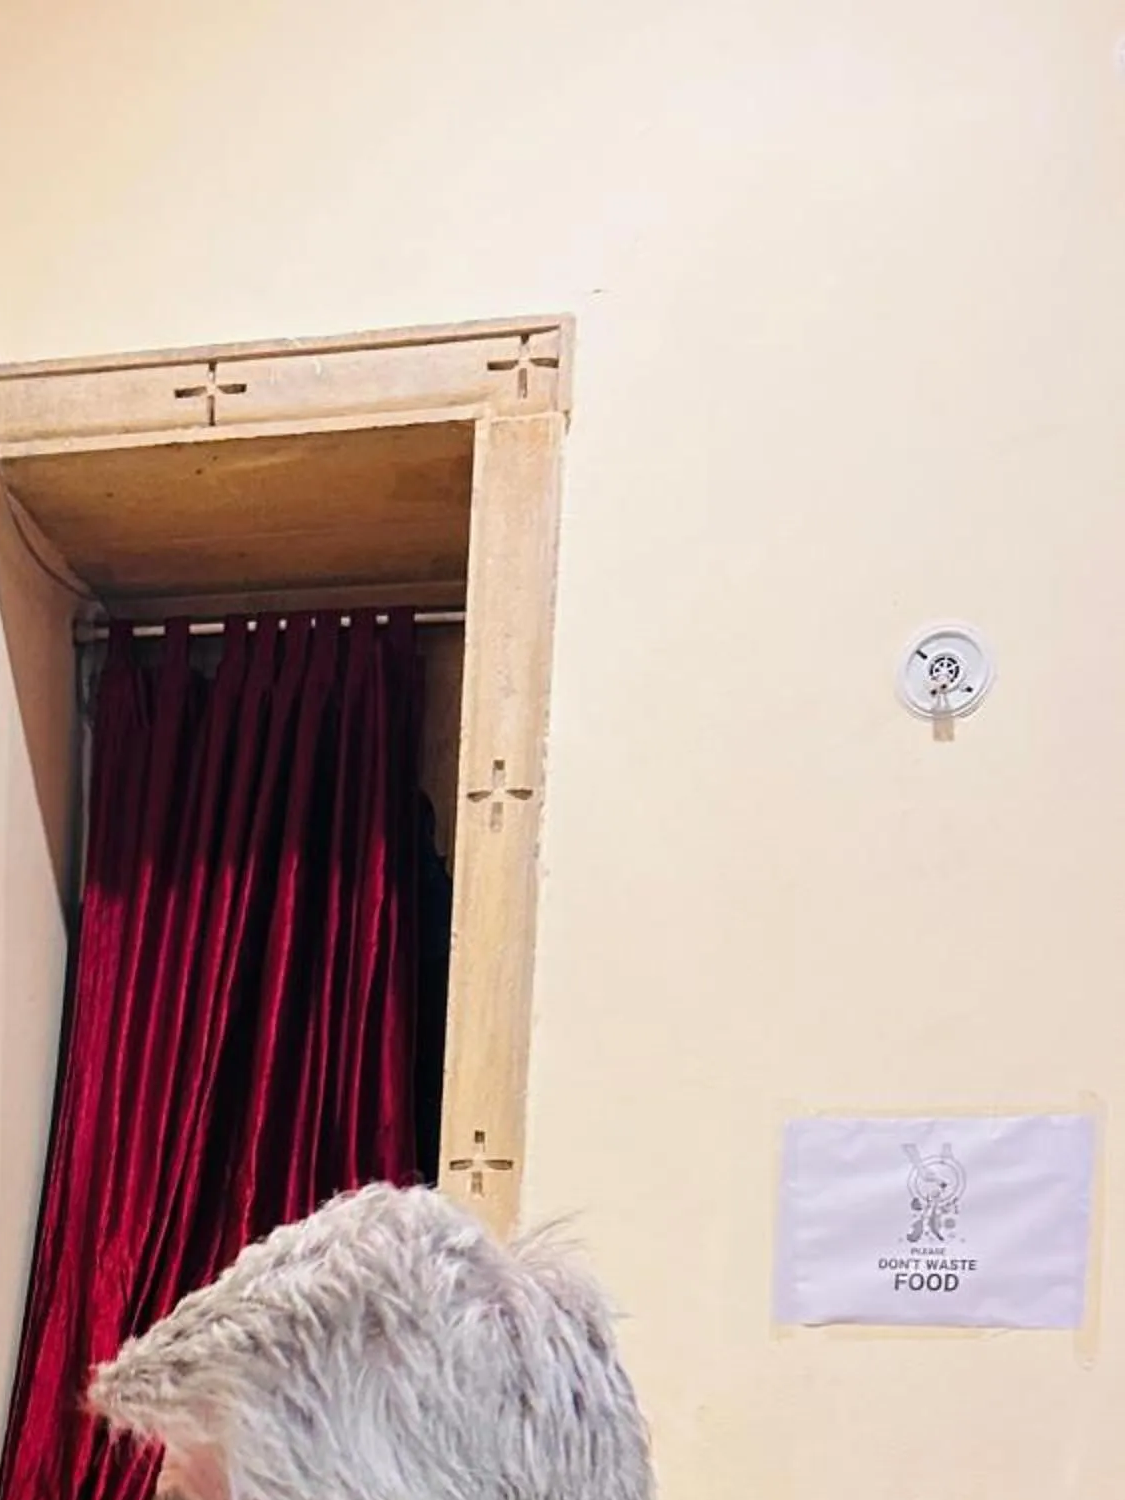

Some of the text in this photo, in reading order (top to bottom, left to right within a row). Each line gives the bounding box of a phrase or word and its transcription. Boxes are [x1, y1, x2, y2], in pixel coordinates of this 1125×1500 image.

[878, 1258, 977, 1271] DON'T WASTE
[894, 1273, 959, 1292] FOOD
